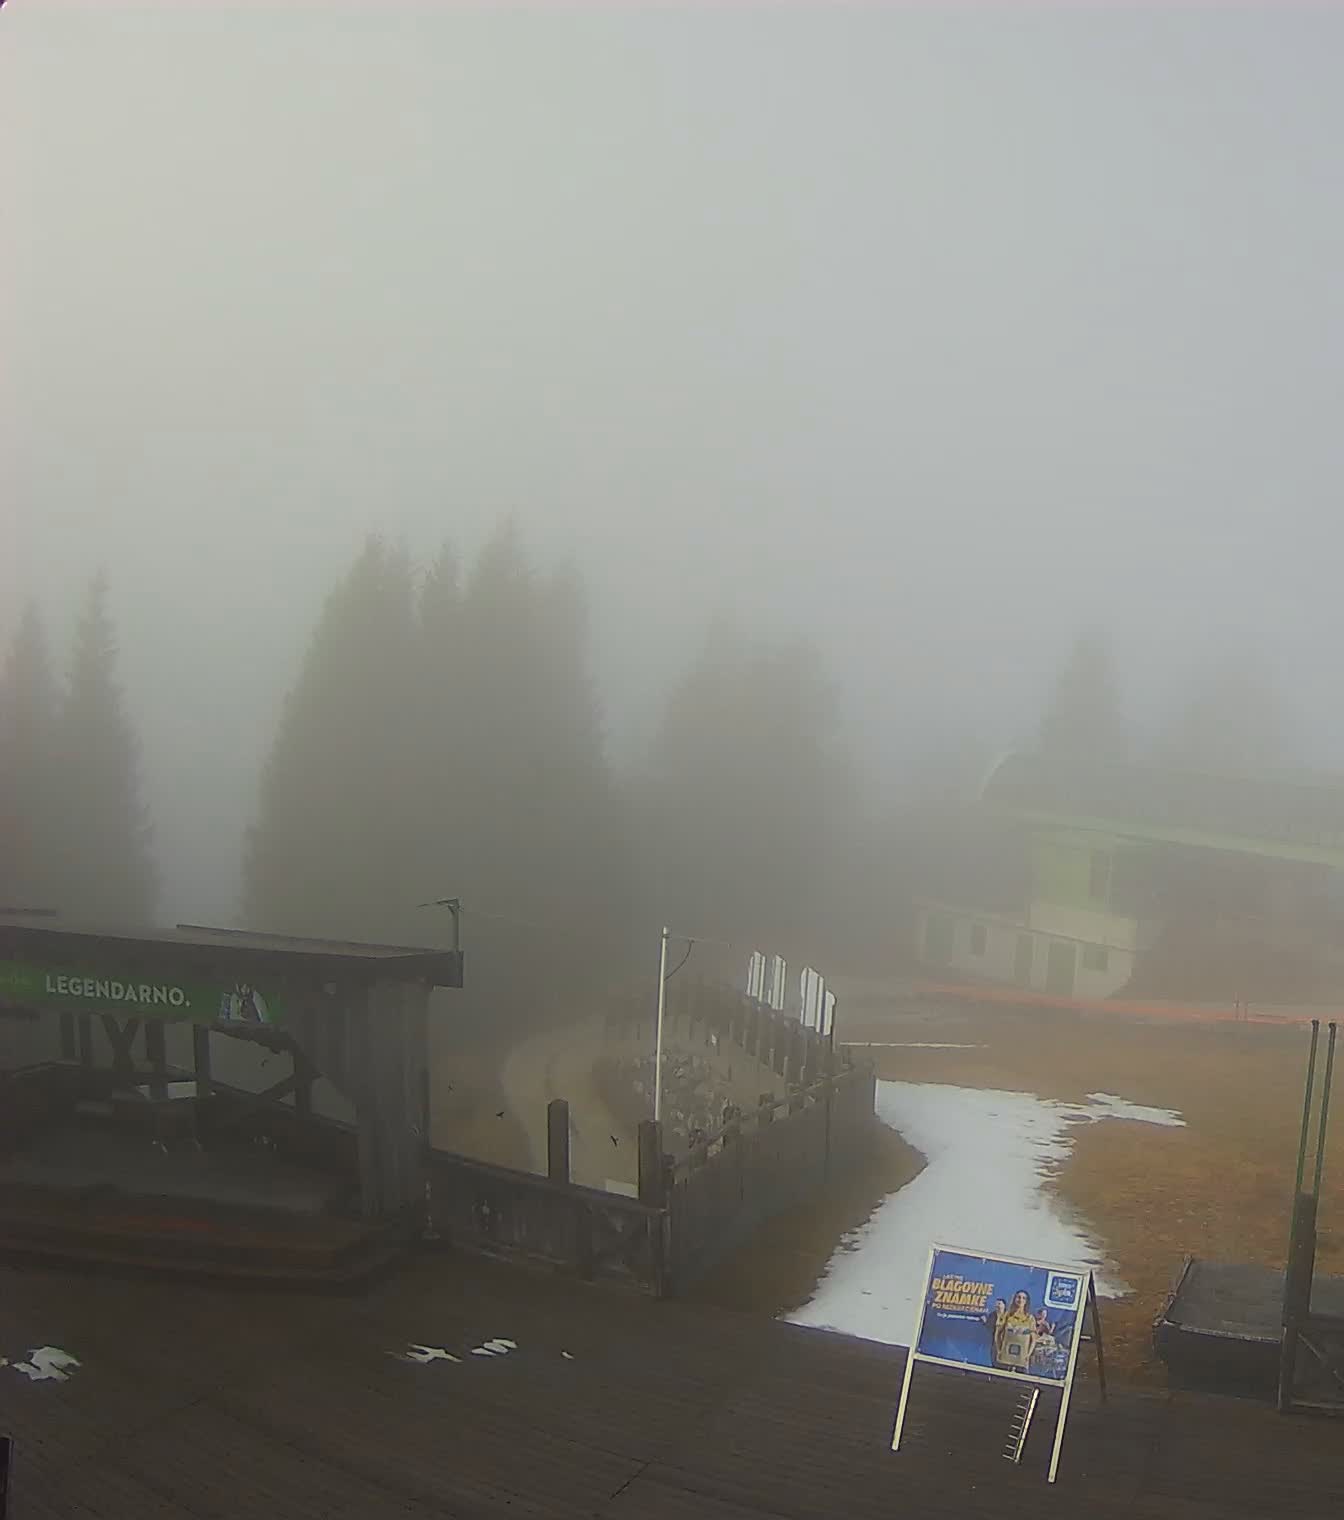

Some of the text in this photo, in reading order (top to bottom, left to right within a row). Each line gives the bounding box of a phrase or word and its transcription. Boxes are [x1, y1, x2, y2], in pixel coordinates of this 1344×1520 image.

[45, 975, 191, 1007] LEGENDARNO.
[932, 1278, 995, 1296] BLAGOVNE
[934, 1291, 988, 1307] ZNAMKE
